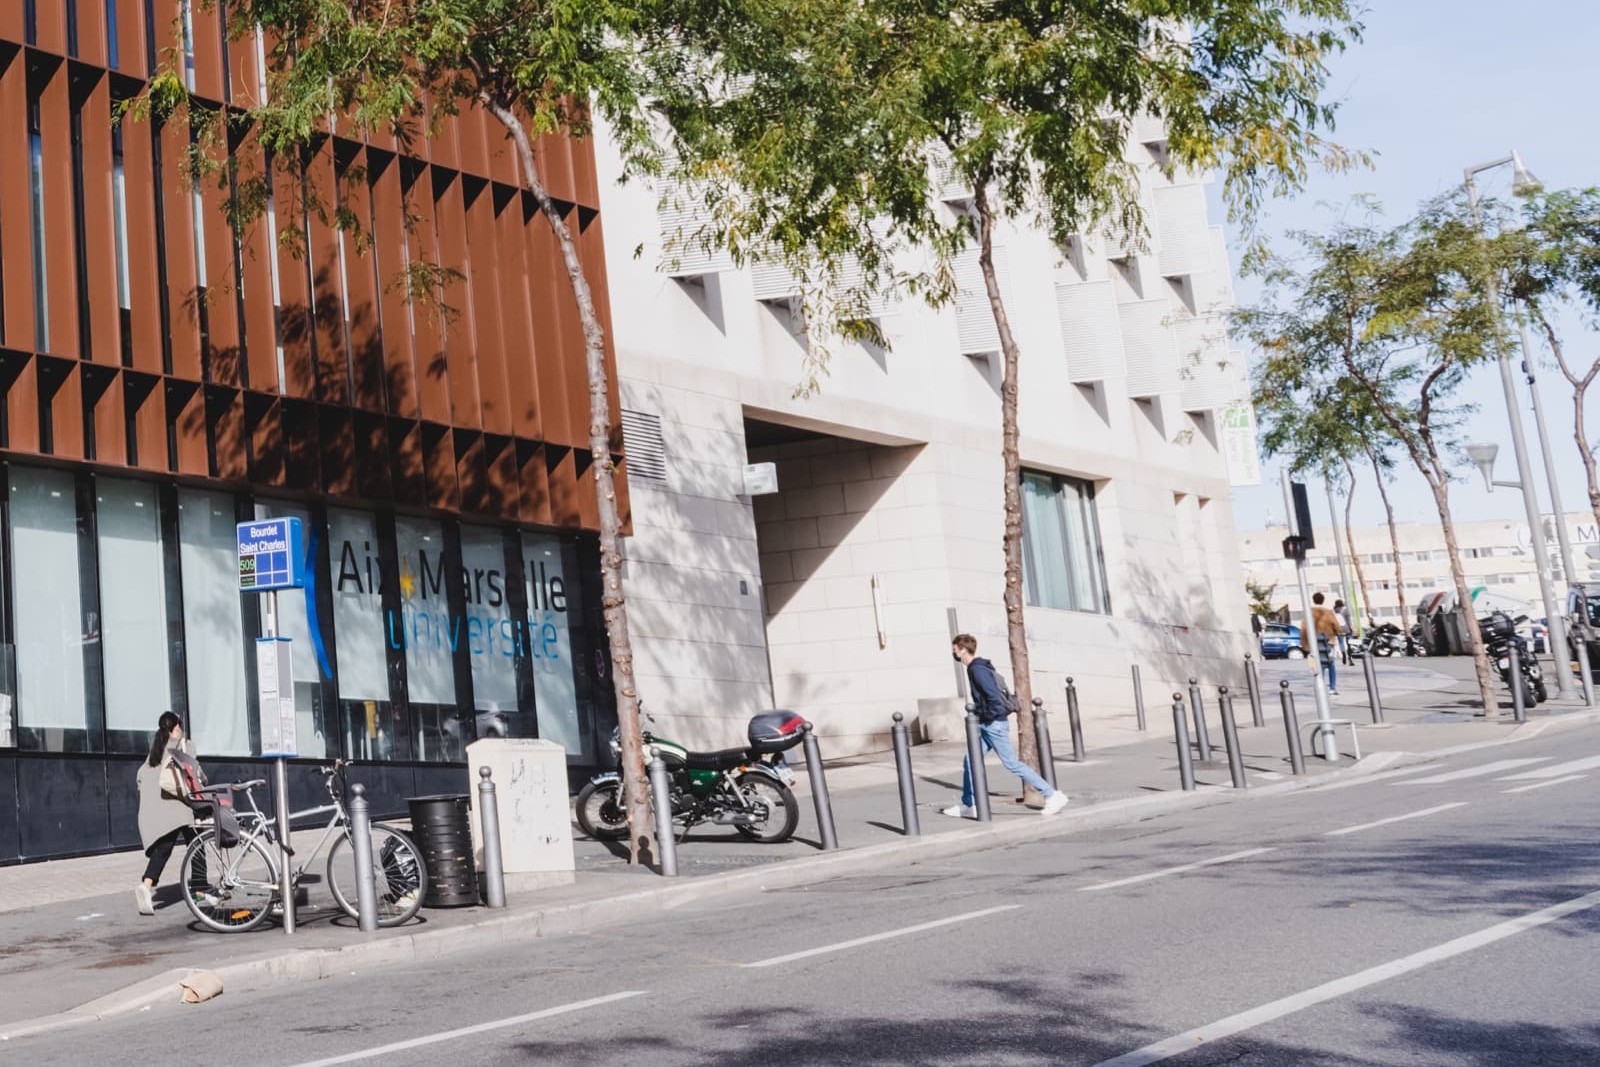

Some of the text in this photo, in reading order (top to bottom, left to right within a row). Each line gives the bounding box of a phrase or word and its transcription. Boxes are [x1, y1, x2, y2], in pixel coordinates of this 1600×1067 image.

[250, 525, 277, 538] Bourdet
[240, 538, 286, 553] Saint Charles
[240, 558, 255, 571] 509
[338, 540, 384, 596] Ai
